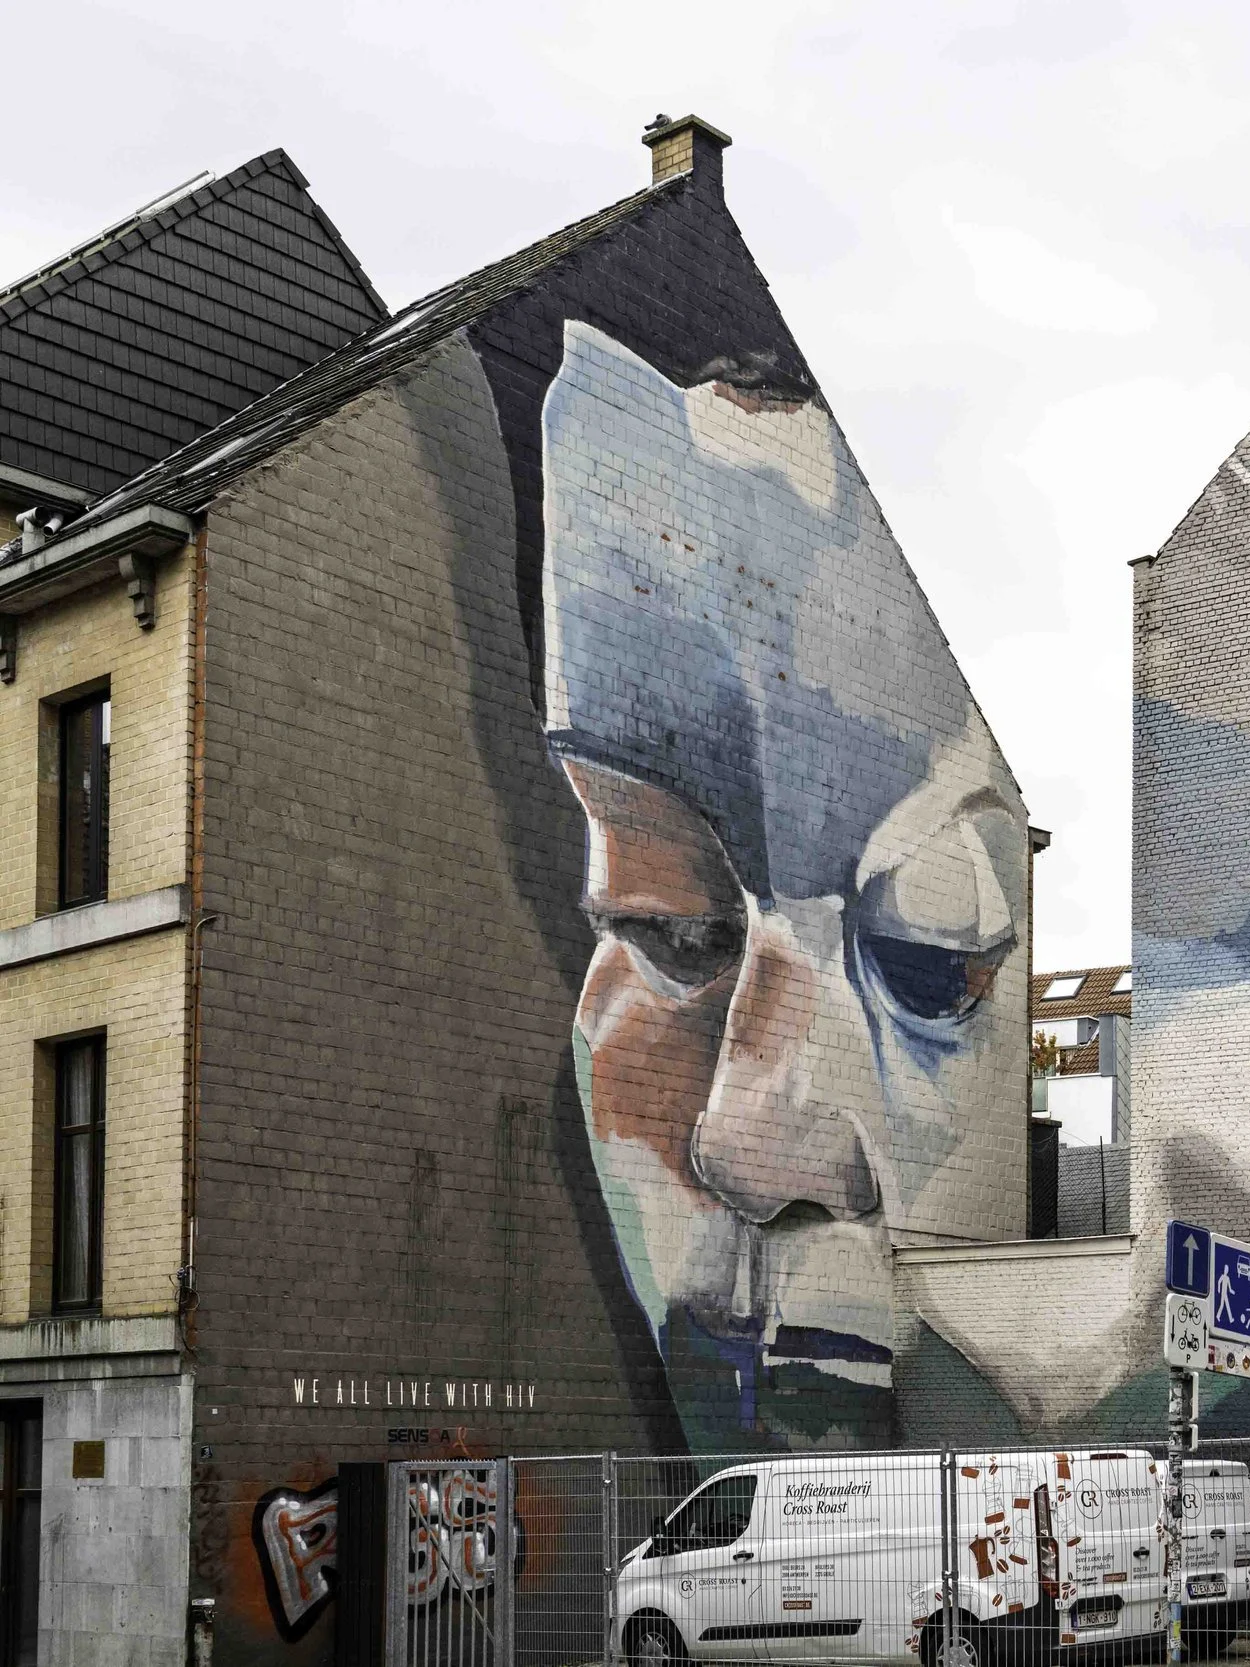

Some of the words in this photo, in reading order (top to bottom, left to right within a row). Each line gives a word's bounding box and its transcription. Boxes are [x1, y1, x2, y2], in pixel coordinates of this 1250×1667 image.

[1186, 1353, 1191, 1363] P
[294, 1378, 319, 1403] WE
[337, 1379, 370, 1405] ALL
[387, 1381, 431, 1406] LIVE
[446, 1383, 492, 1407] WITH
[506, 1384, 535, 1408] HIV
[785, 1481, 871, 1501] Koffiebranderij
[1105, 1489, 1129, 1499] CROSS
[1131, 1487, 1151, 1497] ROAST
[1204, 1492, 1224, 1501] CROSS
[1226, 1492, 1243, 1500] ROAST
[783, 1502, 813, 1516] Cross
[816, 1501, 848, 1515] Roast
[699, 1578, 717, 1586] CROSS
[719, 1577, 738, 1585] ROAST
